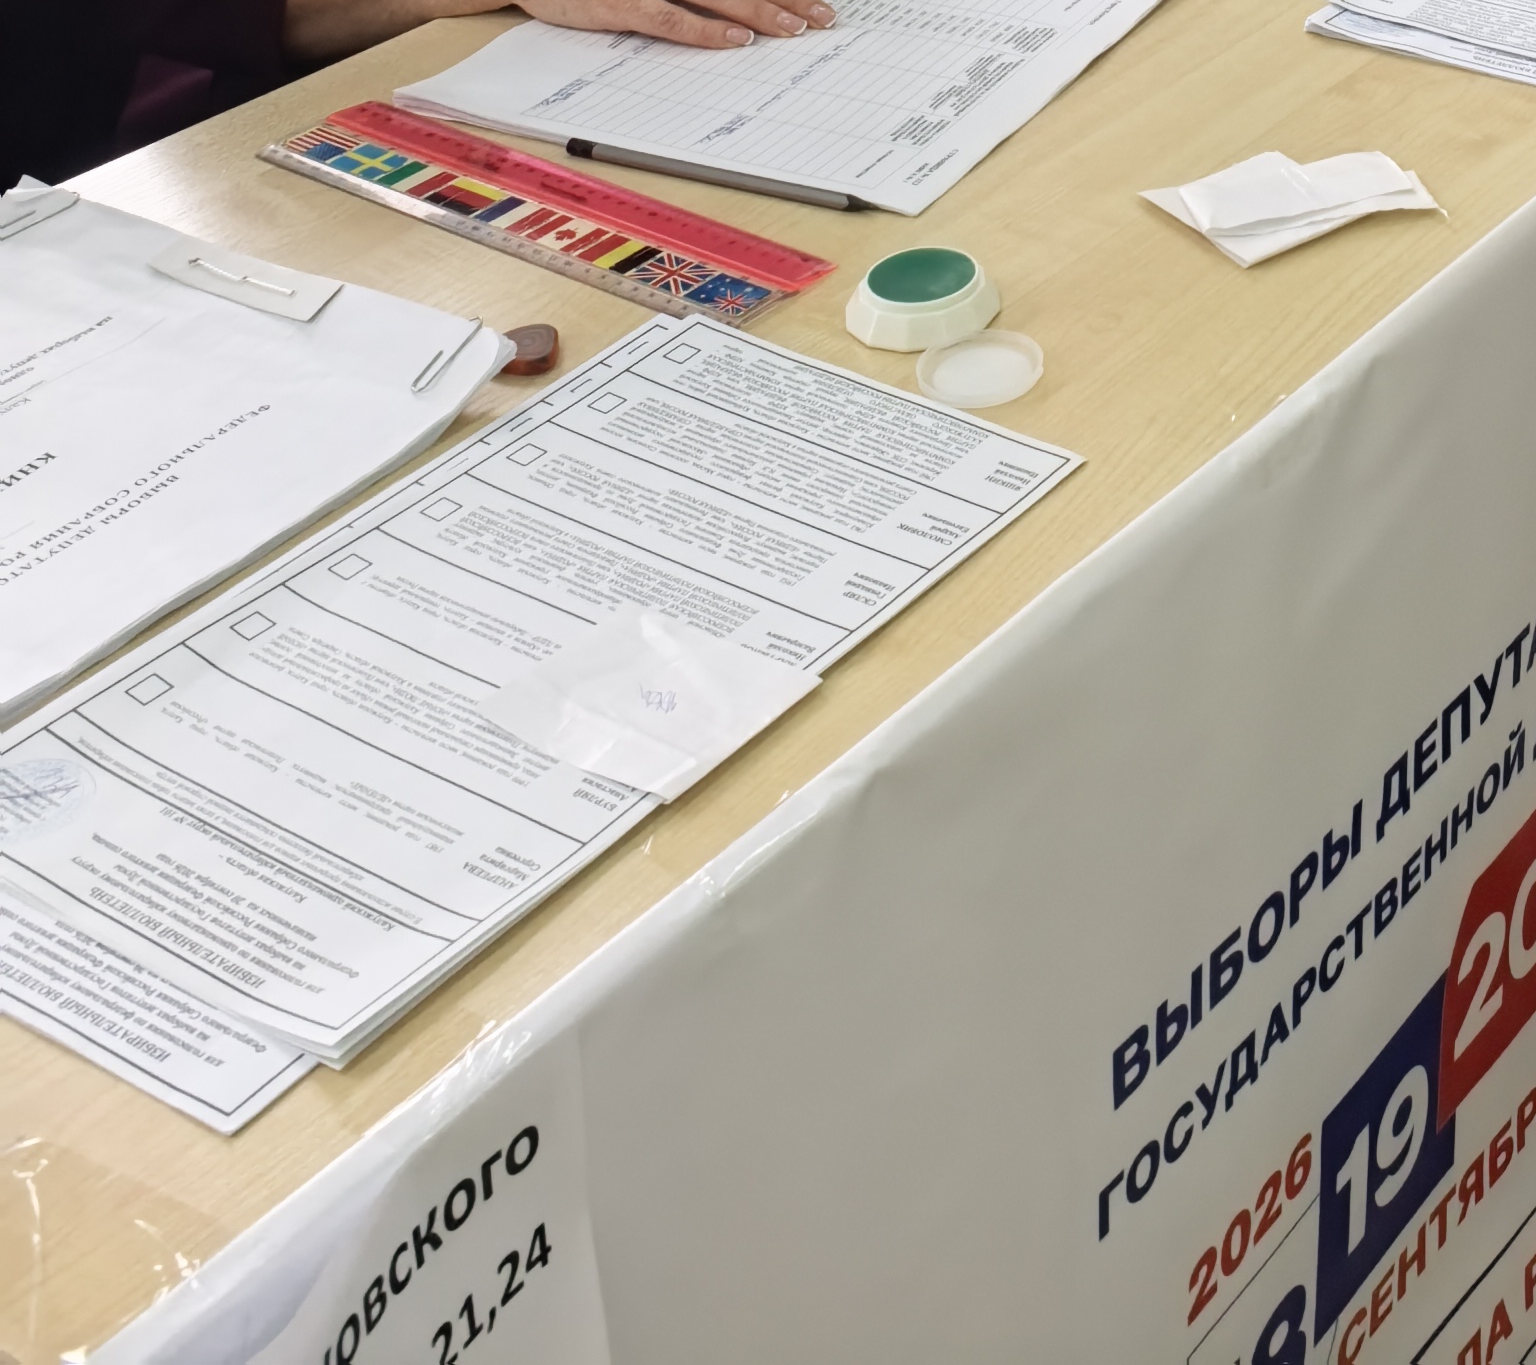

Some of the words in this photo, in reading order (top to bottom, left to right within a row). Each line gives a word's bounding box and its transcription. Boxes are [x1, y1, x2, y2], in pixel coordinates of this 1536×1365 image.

[134, 403, 272, 487] ФЕДЕРАЛЬНОГО
[29, 488, 130, 550] СОБРАНИЯ
[100, 474, 180, 526] ВЫБОРЫ
[90, 887, 163, 931] БЮЛЛЕТЕНЬ
[463, 862, 517, 889] АНДРЕЕВА
[157, 927, 266, 988] ИЗБИРАТЕЛЬНЫЙ
[1097, 722, 1526, 1241] ГОСУДАРСТВЕННОЙ
[1112, 798, 1364, 1110] ВЫБОРЫ
[58, 993, 171, 1062] ИЗБИРАТЕЛЬНЫЙ
[1335, 1064, 1430, 1259] 19
[1188, 1132, 1312, 1327] 2026
